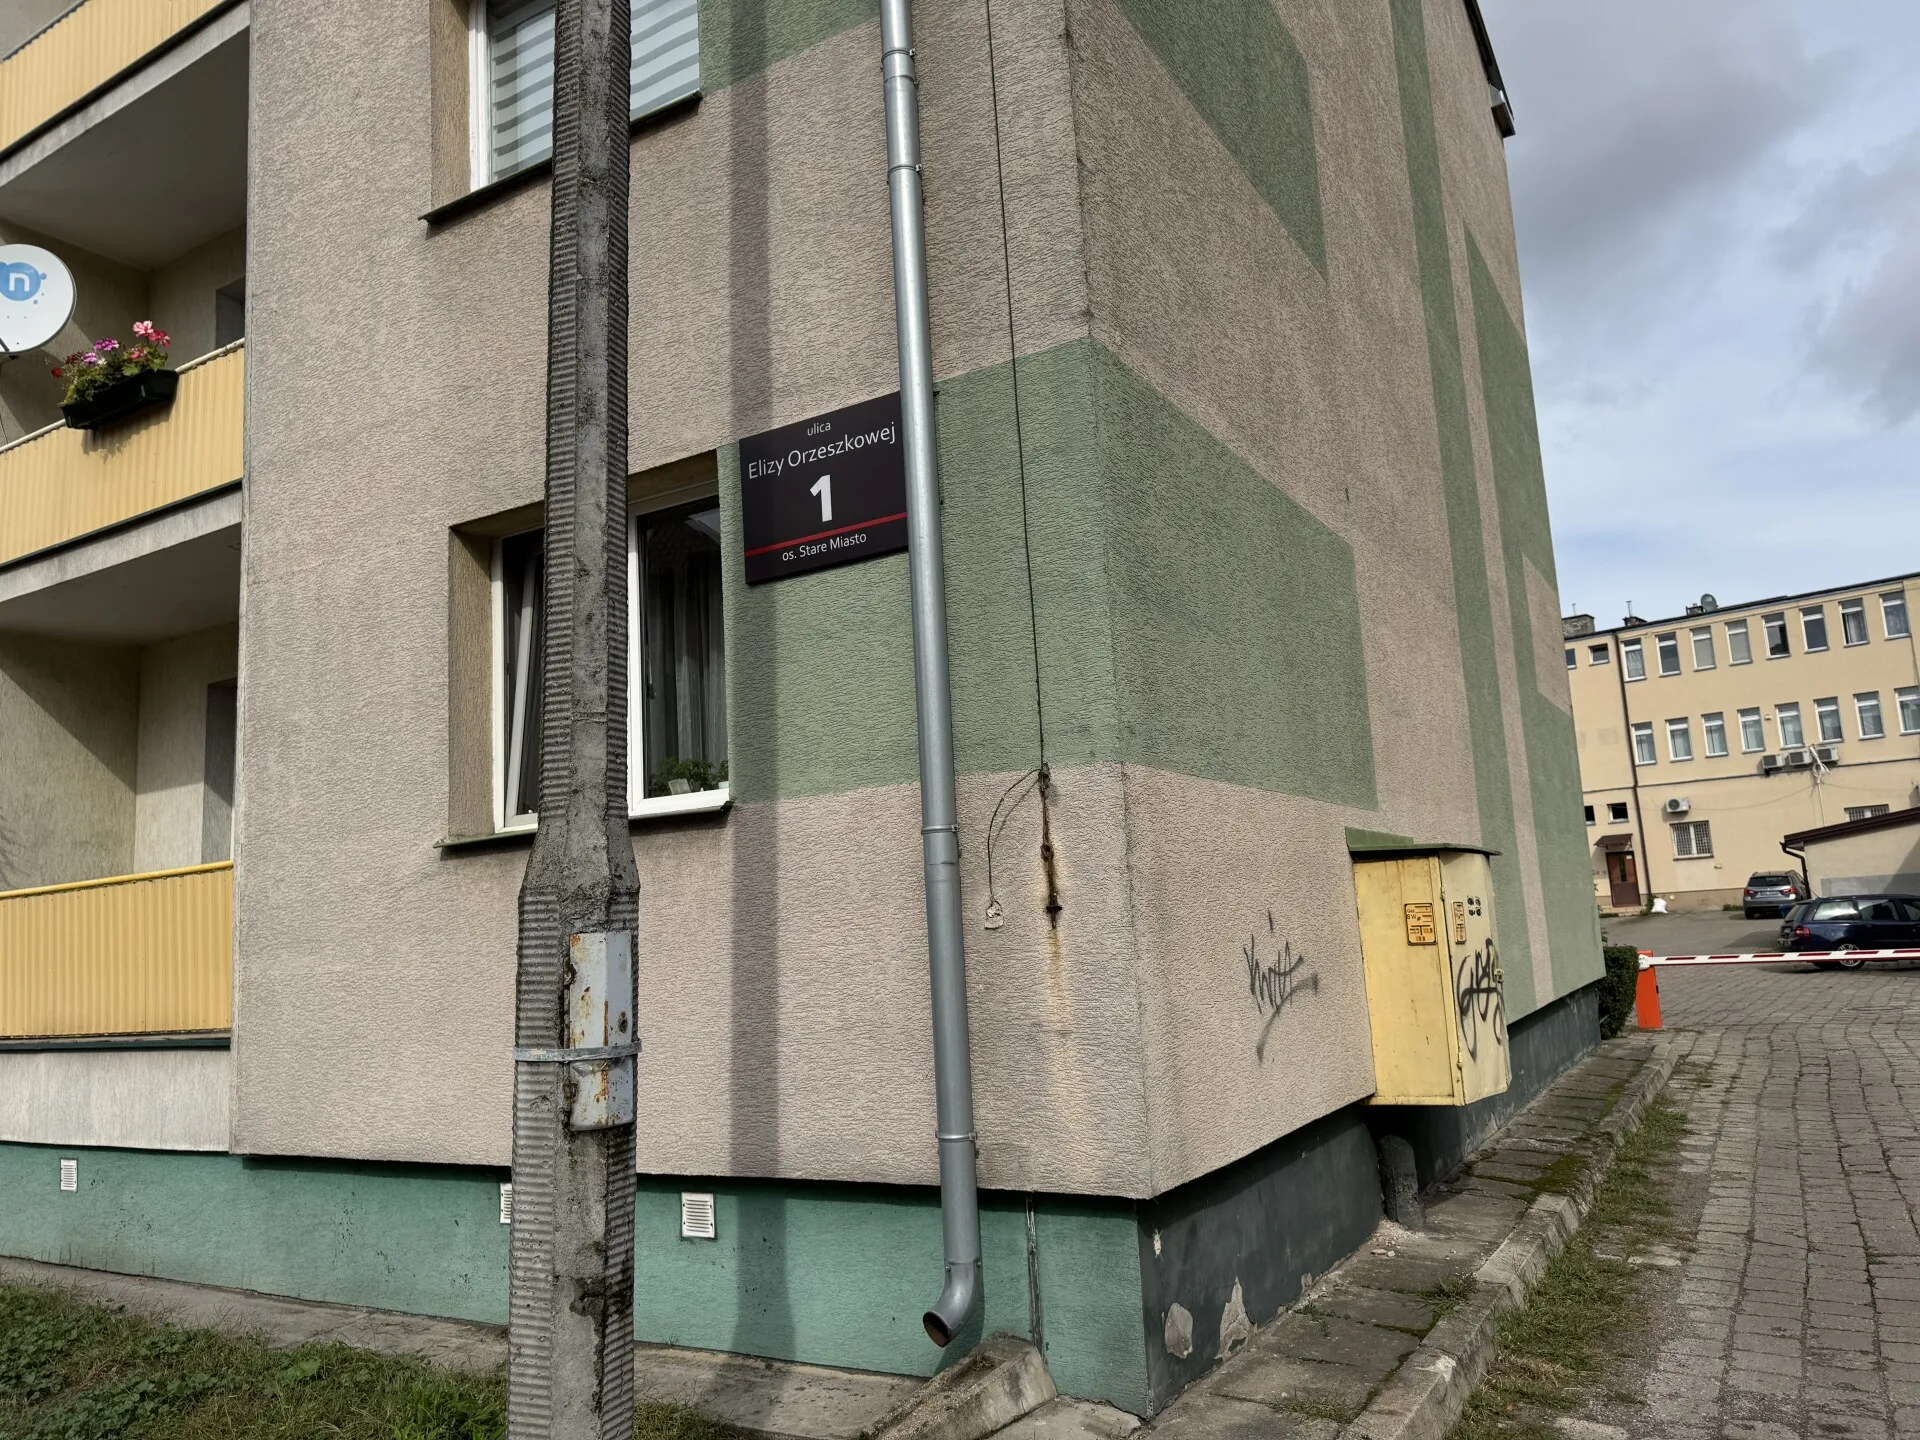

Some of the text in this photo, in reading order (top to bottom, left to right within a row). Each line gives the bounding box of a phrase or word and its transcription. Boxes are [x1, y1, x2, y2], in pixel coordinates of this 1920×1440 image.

[9, 272, 31, 293] n
[807, 421, 832, 437] ulica
[748, 421, 897, 479] Elizy Orzeszkowej
[809, 474, 833, 522] 1
[782, 532, 867, 562] os. Stare Miasto
